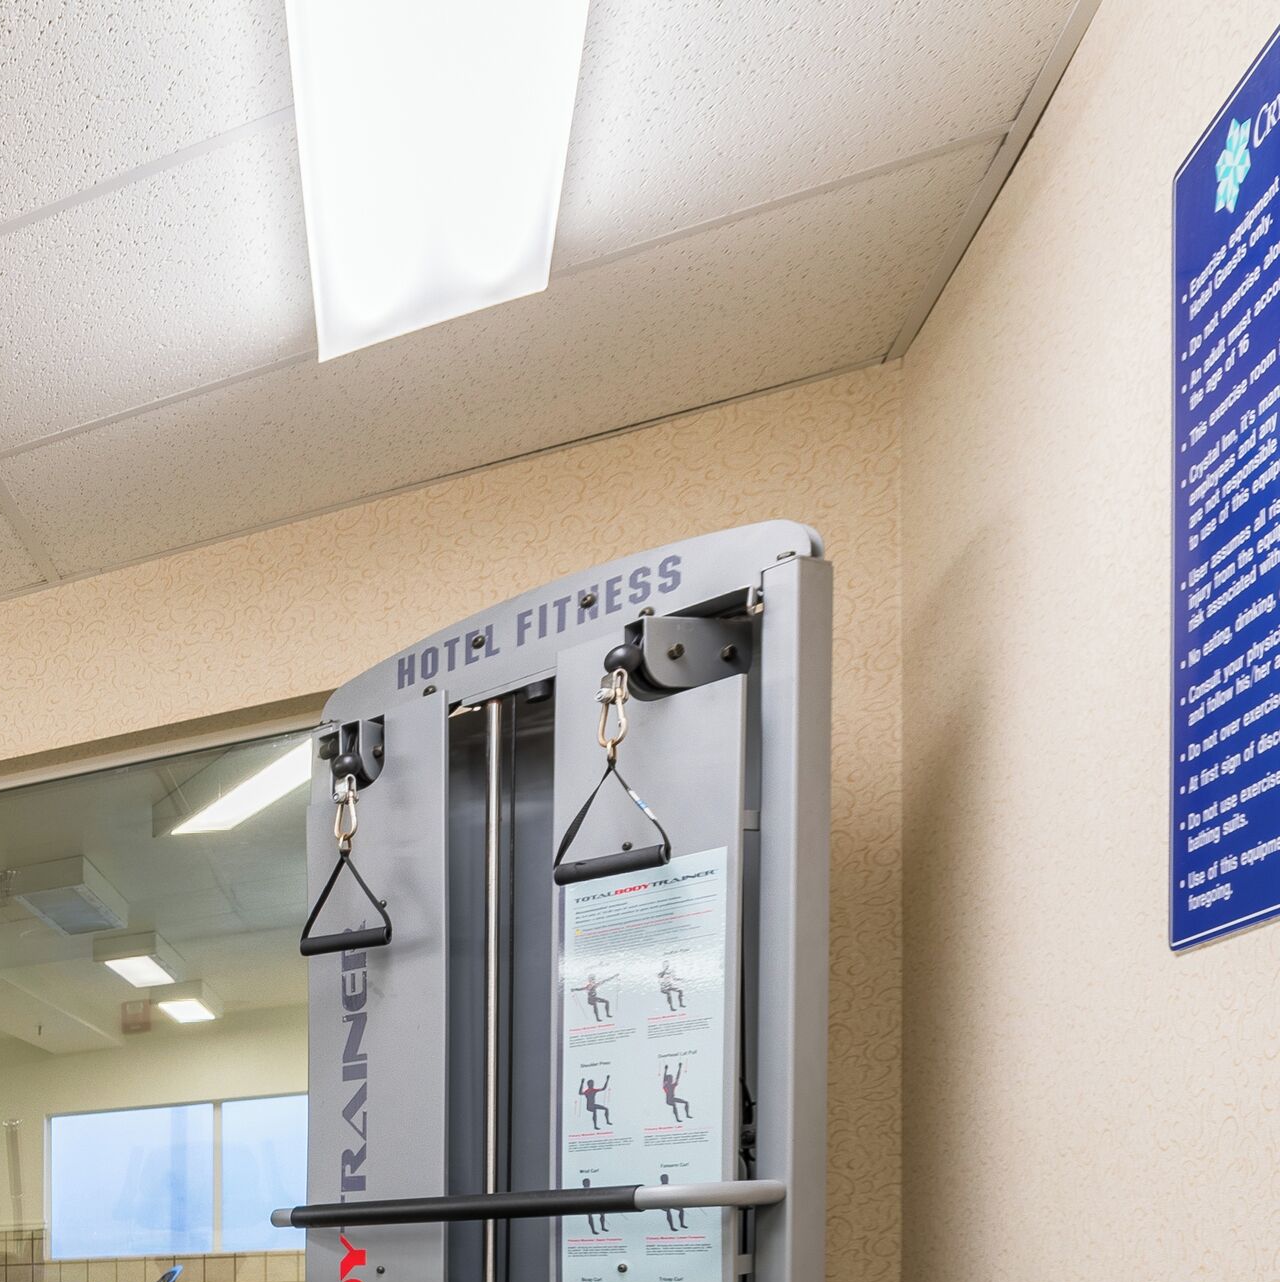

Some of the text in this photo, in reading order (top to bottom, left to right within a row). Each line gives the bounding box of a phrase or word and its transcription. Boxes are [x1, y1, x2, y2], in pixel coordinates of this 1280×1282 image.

[1189, 175, 1279, 298] Exercise equipment
[1189, 213, 1273, 321] Hotel Guests only.
[1189, 334, 1202, 357] Do
[1203, 310, 1219, 340] not
[1221, 265, 1260, 319] exercise
[1203, 337, 1226, 373] adult
[1227, 307, 1251, 346] must
[1189, 333, 1249, 411] the age of 16
[1189, 348, 1276, 447] This exercise room
[1189, 411, 1277, 507] employees and any
[1189, 440, 1219, 484] Crystal
[1189, 437, 1277, 530] are not responsible
[1188, 561, 1209, 588] User
[1210, 525, 1251, 569] assumes
[1253, 507, 1266, 533] all
[1189, 534, 1199, 551] to
[1200, 517, 1217, 542] use
[1218, 500, 1229, 525] of
[1231, 487, 1249, 513] this
[1188, 581, 1212, 611] injury
[1213, 562, 1235, 589] from
[1237, 547, 1254, 569] the
[1188, 608, 1204, 633] risk
[1206, 563, 1257, 619] associated
[397, 554, 682, 690] HOTEL FITNESS
[1188, 593, 1277, 668] No eating, drinking,
[1188, 668, 1221, 704] Consult
[1223, 655, 1245, 684] your
[1188, 660, 1272, 727] and follow his/her
[1188, 692, 1280, 762] Do not over exercis
[1188, 775, 1199, 795] At
[1200, 762, 1219, 787] first
[1221, 753, 1241, 775] sign
[1243, 740, 1255, 762] of
[1187, 812, 1201, 831] Do
[1202, 801, 1219, 823] not
[1220, 794, 1238, 814] use
[1187, 813, 1249, 853] bathing suits.
[1187, 871, 1206, 890] Use
[1207, 860, 1219, 881] of
[1220, 854, 1238, 875] this
[1188, 882, 1234, 911] foregoing.
